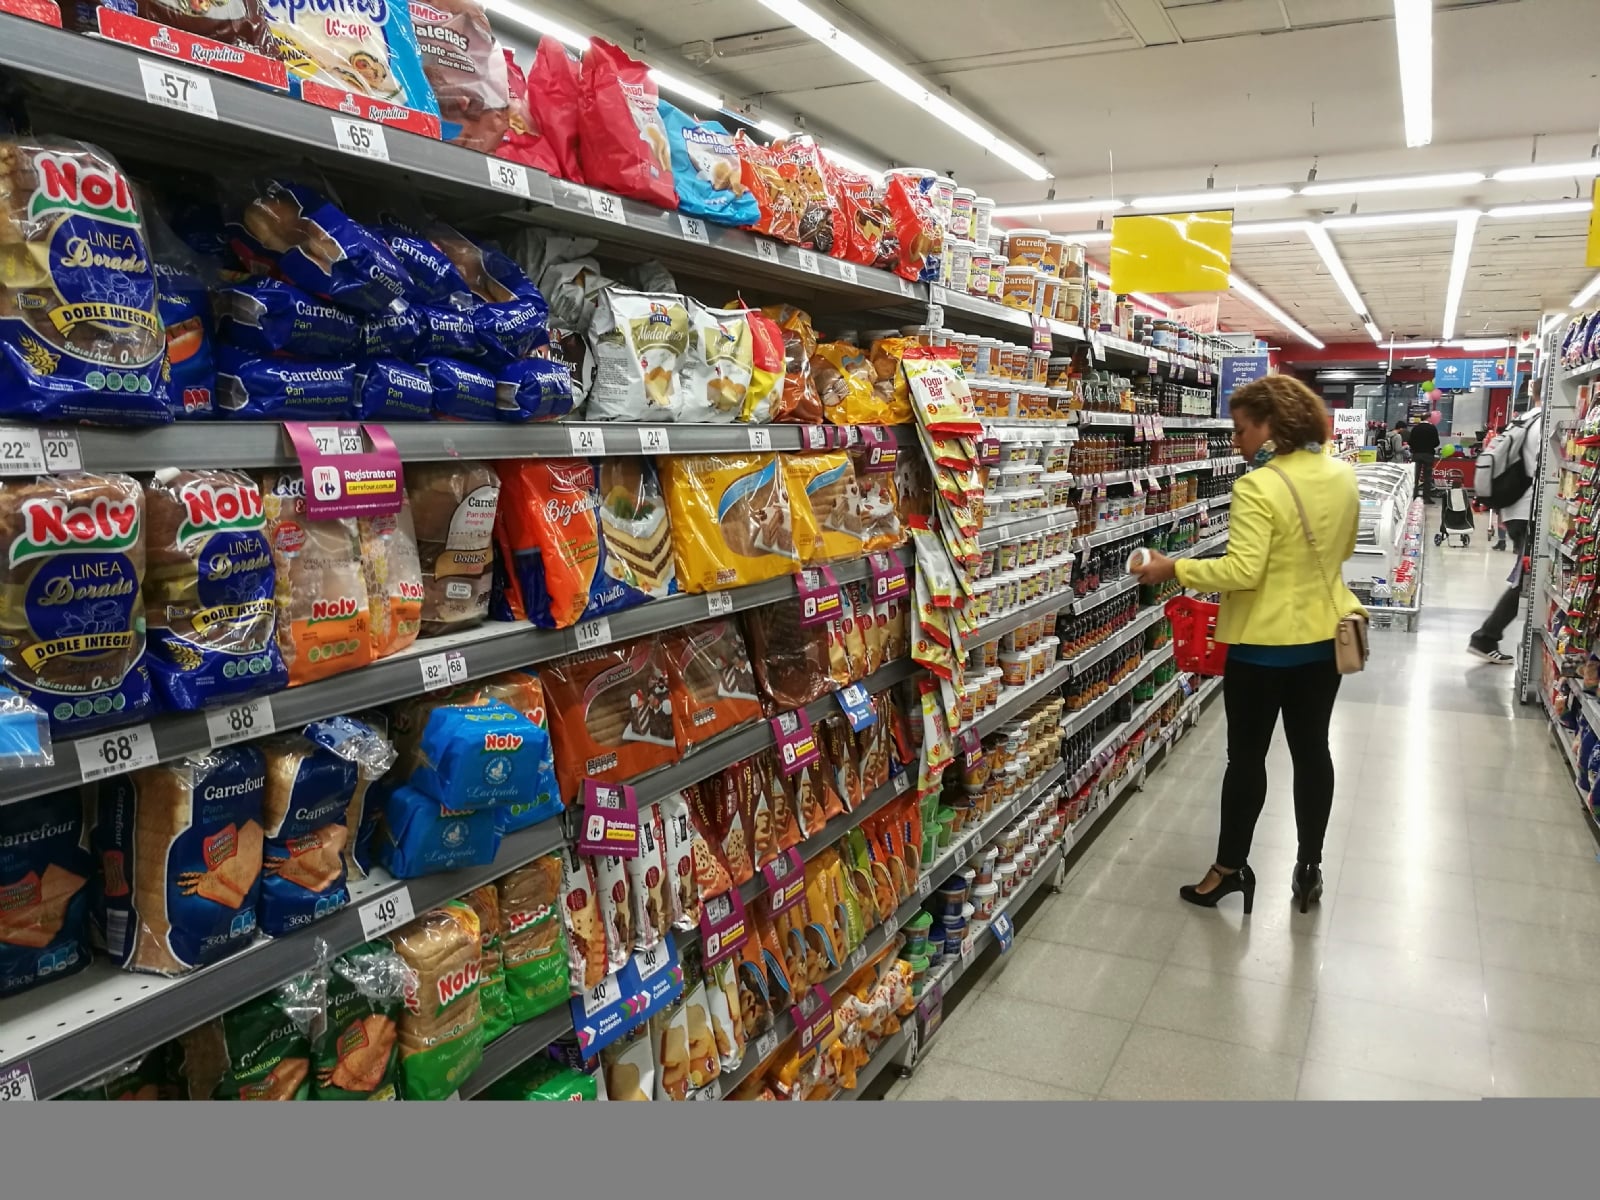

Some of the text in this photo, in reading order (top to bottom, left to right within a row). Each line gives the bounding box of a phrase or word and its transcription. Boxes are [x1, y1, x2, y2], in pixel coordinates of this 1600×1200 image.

[191, 44, 245, 63] Rapiditas
[369, 105, 408, 122] Rapiditas
[88, 230, 135, 250] LINEA
[61, 236, 147, 273] Dorada
[63, 306, 108, 323] DOBLE
[279, 368, 344, 383] Carrefour
[920, 377, 943, 390] Yogu
[285, 386, 304, 396] Pan
[387, 387, 403, 398] Pan
[929, 386, 944, 397] Bar
[1338, 413, 1363, 423] Nueva!
[320, 470, 331, 481] mi
[344, 469, 396, 482] Registrate en
[184, 486, 262, 524] Noly
[29, 501, 136, 543] Noly
[229, 541, 262, 556] LINEA
[207, 552, 271, 580] Dorada
[454, 553, 480, 564] Doble
[72, 561, 123, 580] LINEA
[37, 575, 134, 606] Dorada
[201, 608, 233, 625] DOBLE
[312, 598, 355, 619] Noly
[35, 638, 80, 660] DOBLE
[485, 734, 522, 749] Noly
[204, 775, 265, 800] Carrefour
[288, 914, 312, 927] 360g
[600, 1012, 618, 1027] Precios
[600, 1018, 622, 1036] Cuidados
